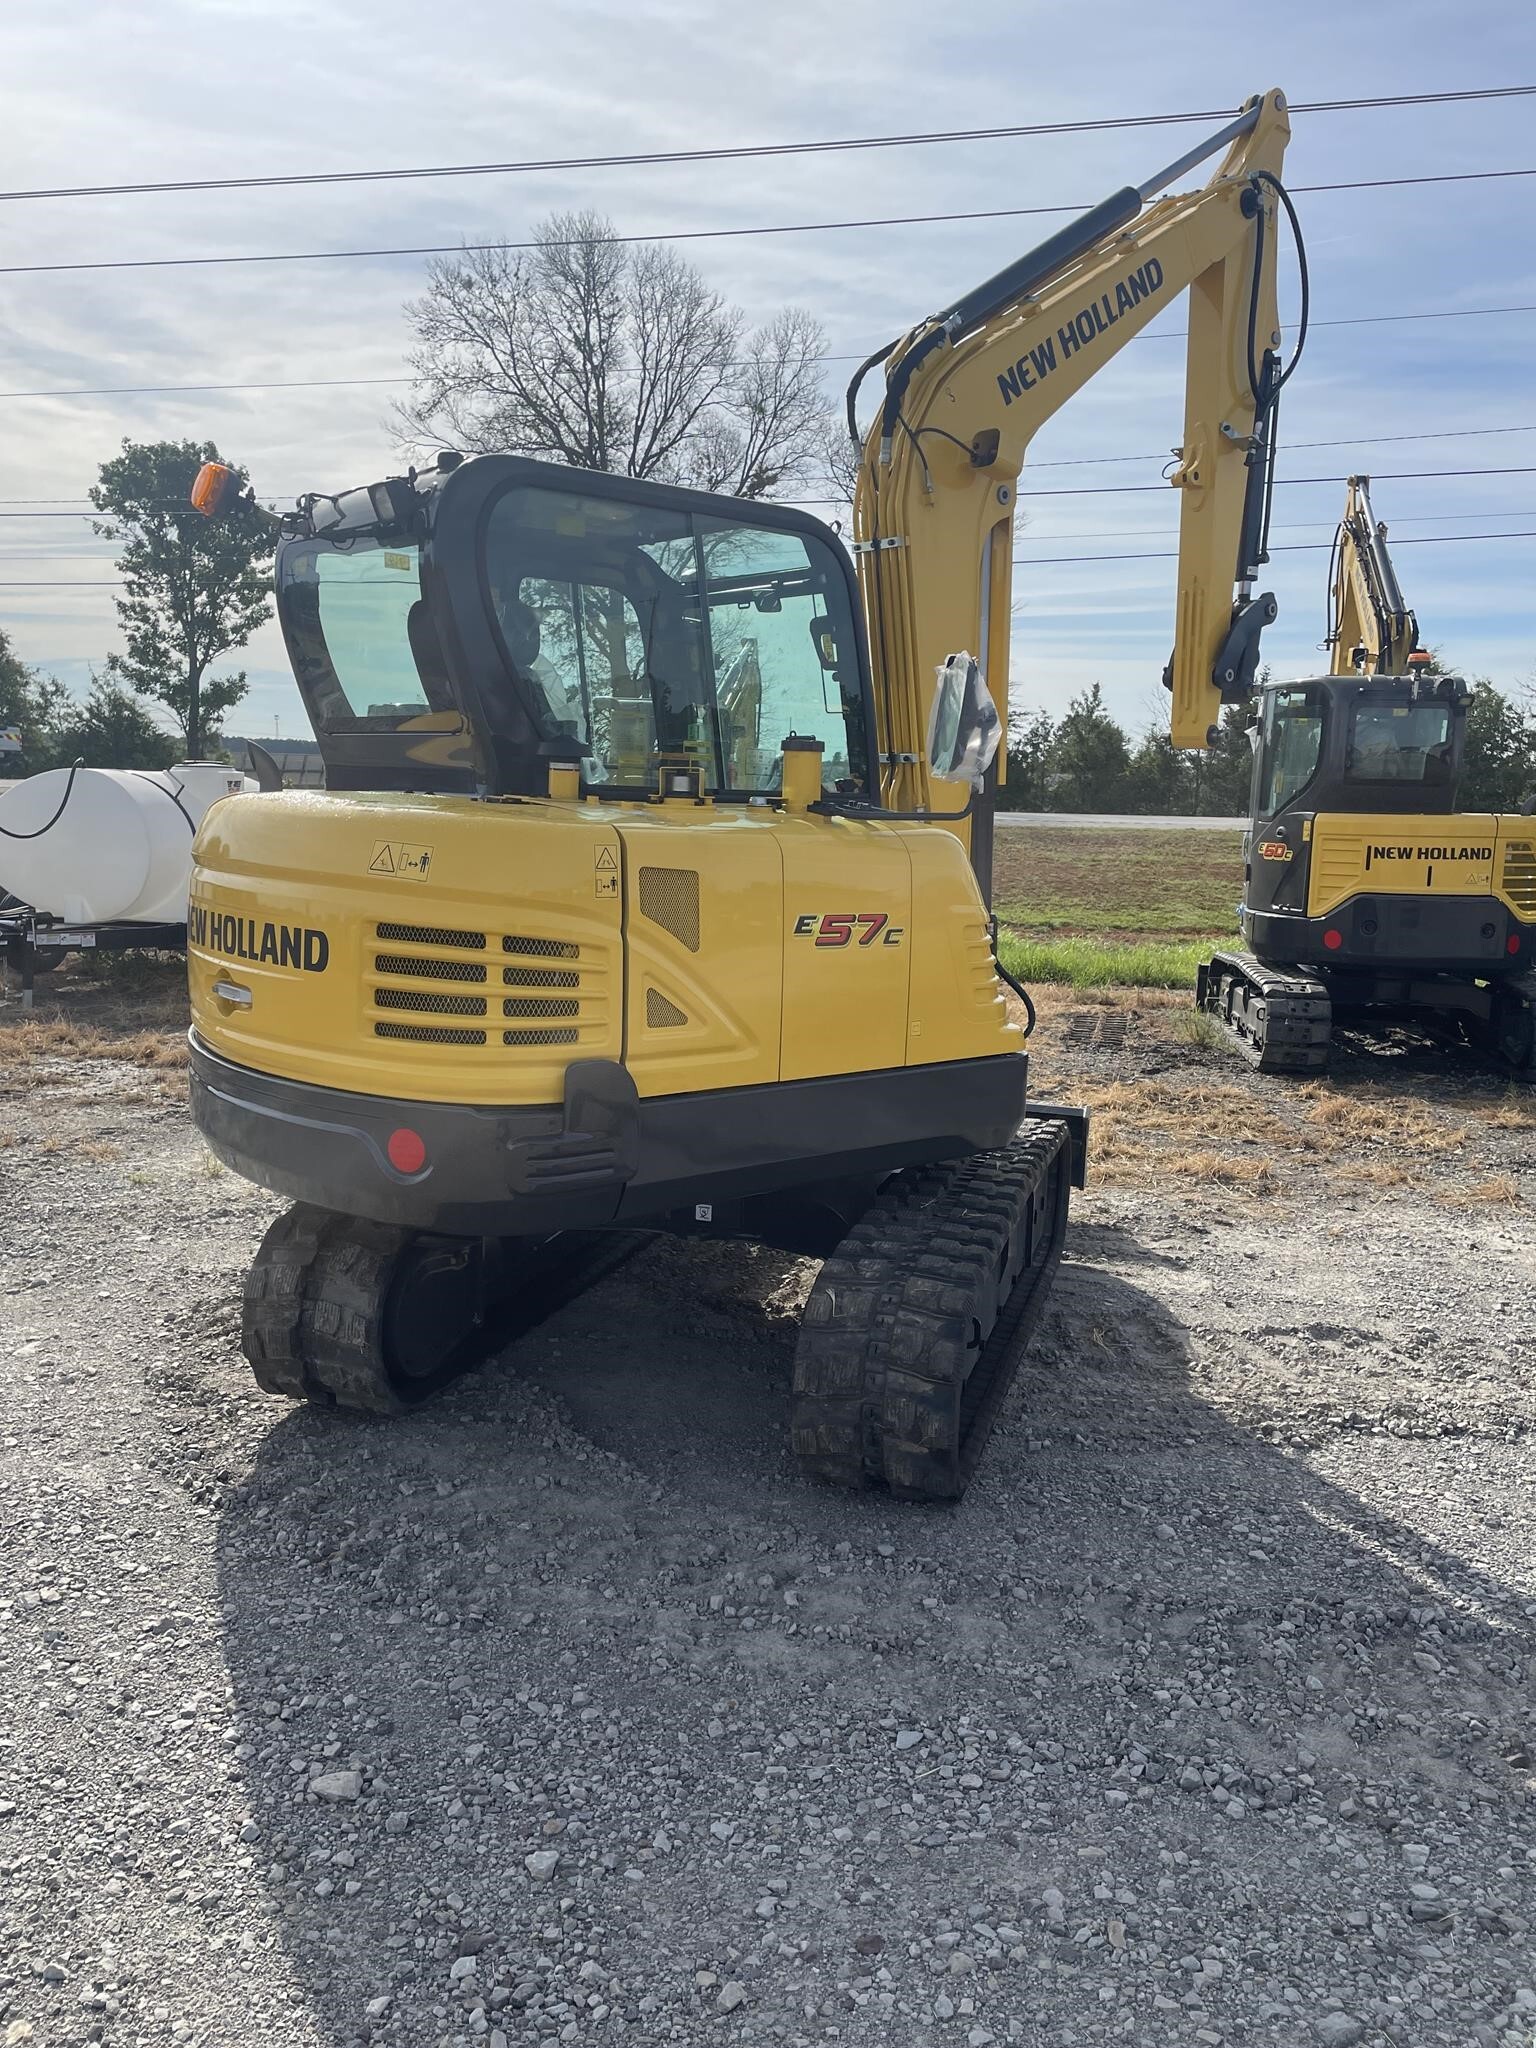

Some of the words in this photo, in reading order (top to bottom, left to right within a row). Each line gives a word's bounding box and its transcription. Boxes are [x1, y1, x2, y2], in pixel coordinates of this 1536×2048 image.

[997, 337, 1057, 406] NEW
[1057, 257, 1164, 360] HOLLAND
[1373, 847, 1413, 860] NEW
[1417, 847, 1492, 860] HOLLAND
[187, 904, 207, 947] EW
[210, 911, 329, 973] HOLLAND
[794, 913, 904, 947] E57C
